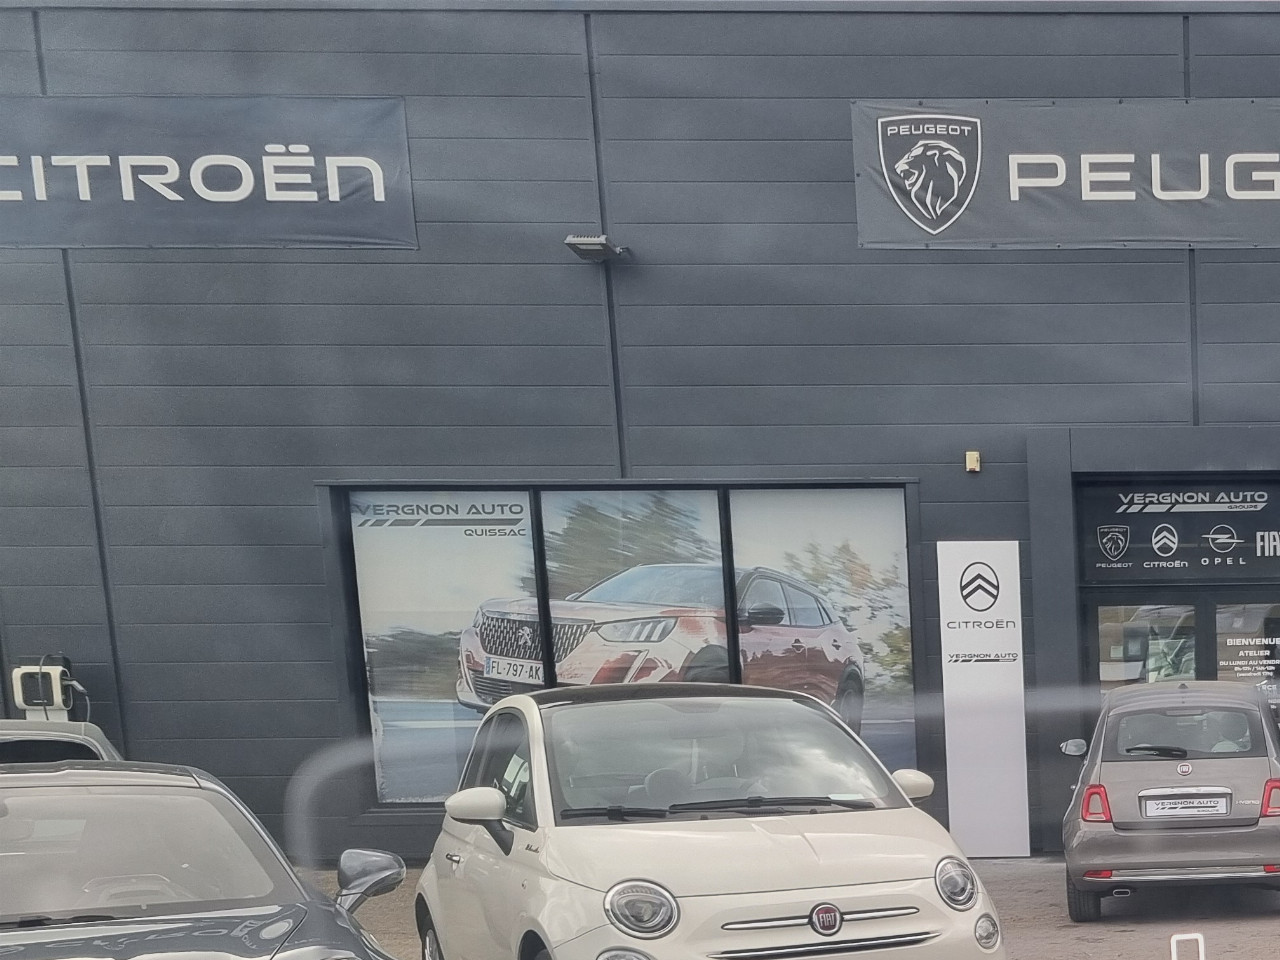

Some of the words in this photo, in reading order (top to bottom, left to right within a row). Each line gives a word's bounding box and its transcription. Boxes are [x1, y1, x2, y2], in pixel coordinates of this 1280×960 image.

[887, 124, 972, 136] PEUGEOT
[1118, 492, 1210, 504] VERGNON
[1214, 491, 1269, 503] AUTO
[354, 503, 459, 516] VERGNON
[466, 503, 524, 515] AUTO
[463, 528, 527, 537] QUISSAC
[1200, 557, 1247, 565] OPEL
[819, 912, 836, 927] FIAT
